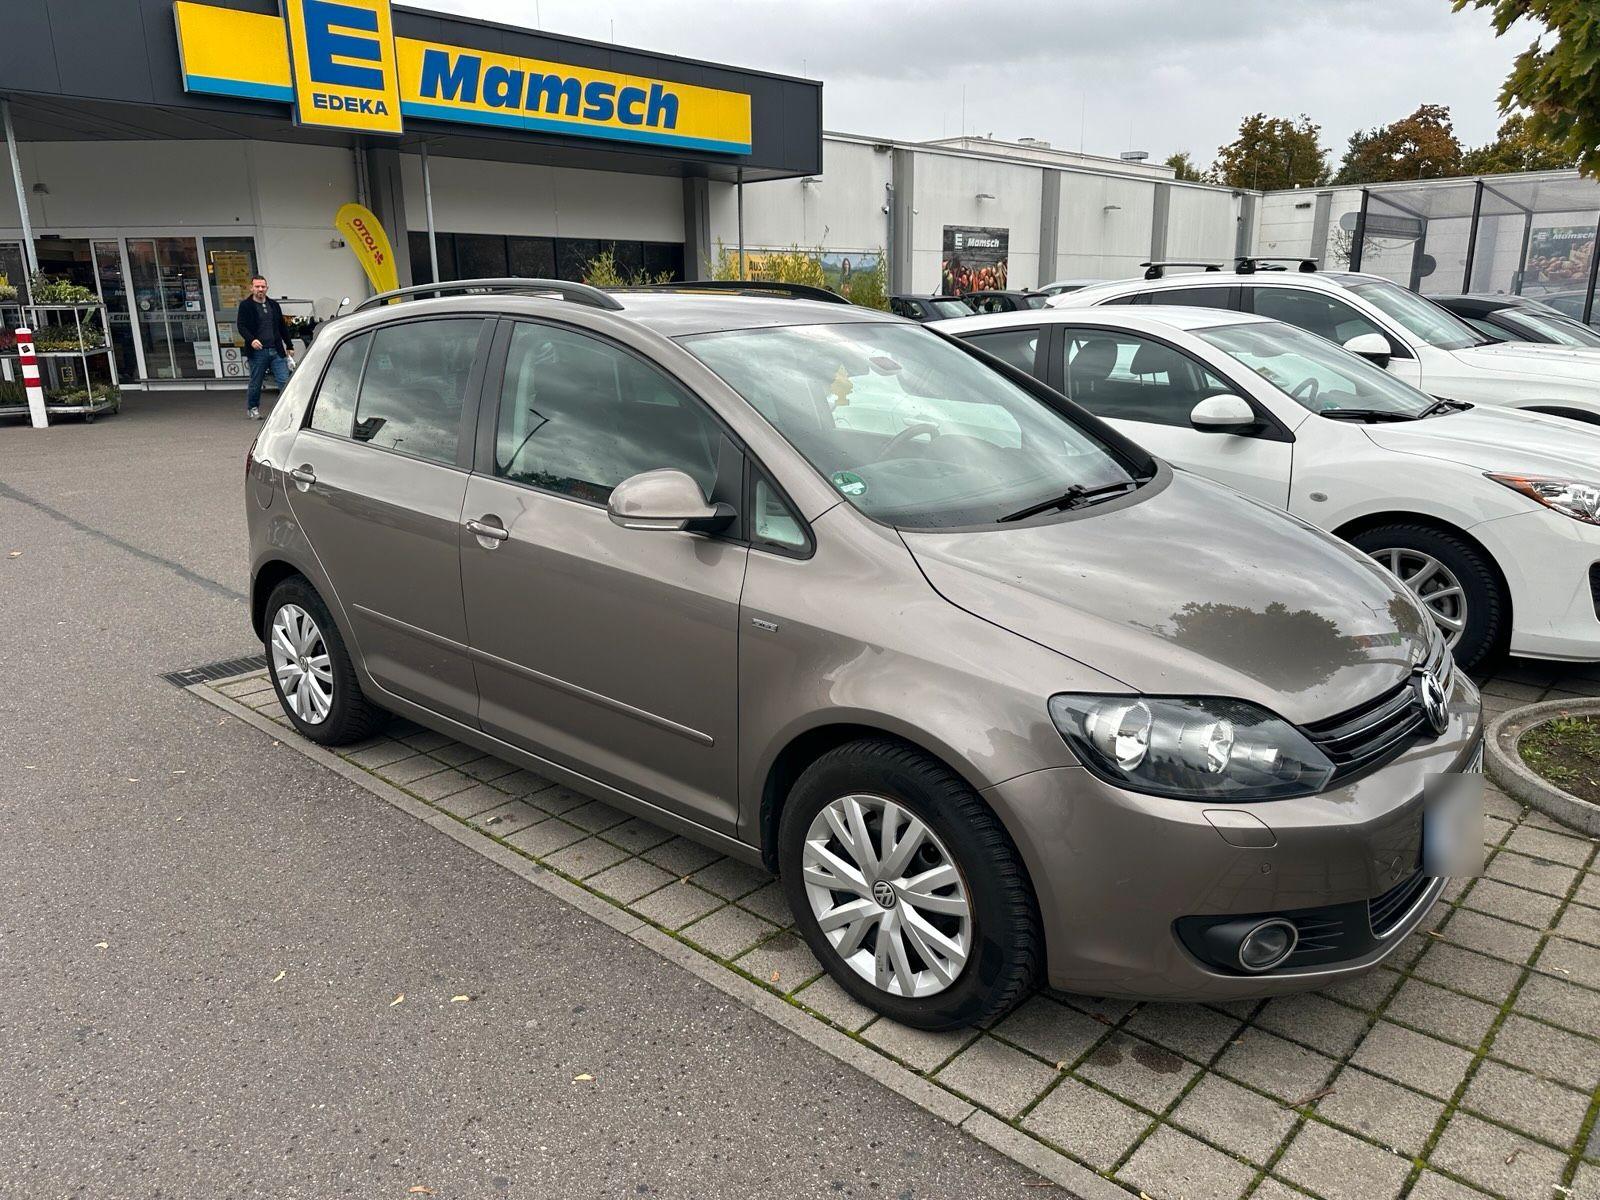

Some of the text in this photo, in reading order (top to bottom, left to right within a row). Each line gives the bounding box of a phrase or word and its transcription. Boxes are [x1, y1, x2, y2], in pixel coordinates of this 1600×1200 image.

[419, 48, 679, 130] Mamsch
[312, 92, 389, 116] EDEKA
[967, 237, 1000, 248] Mamsch
